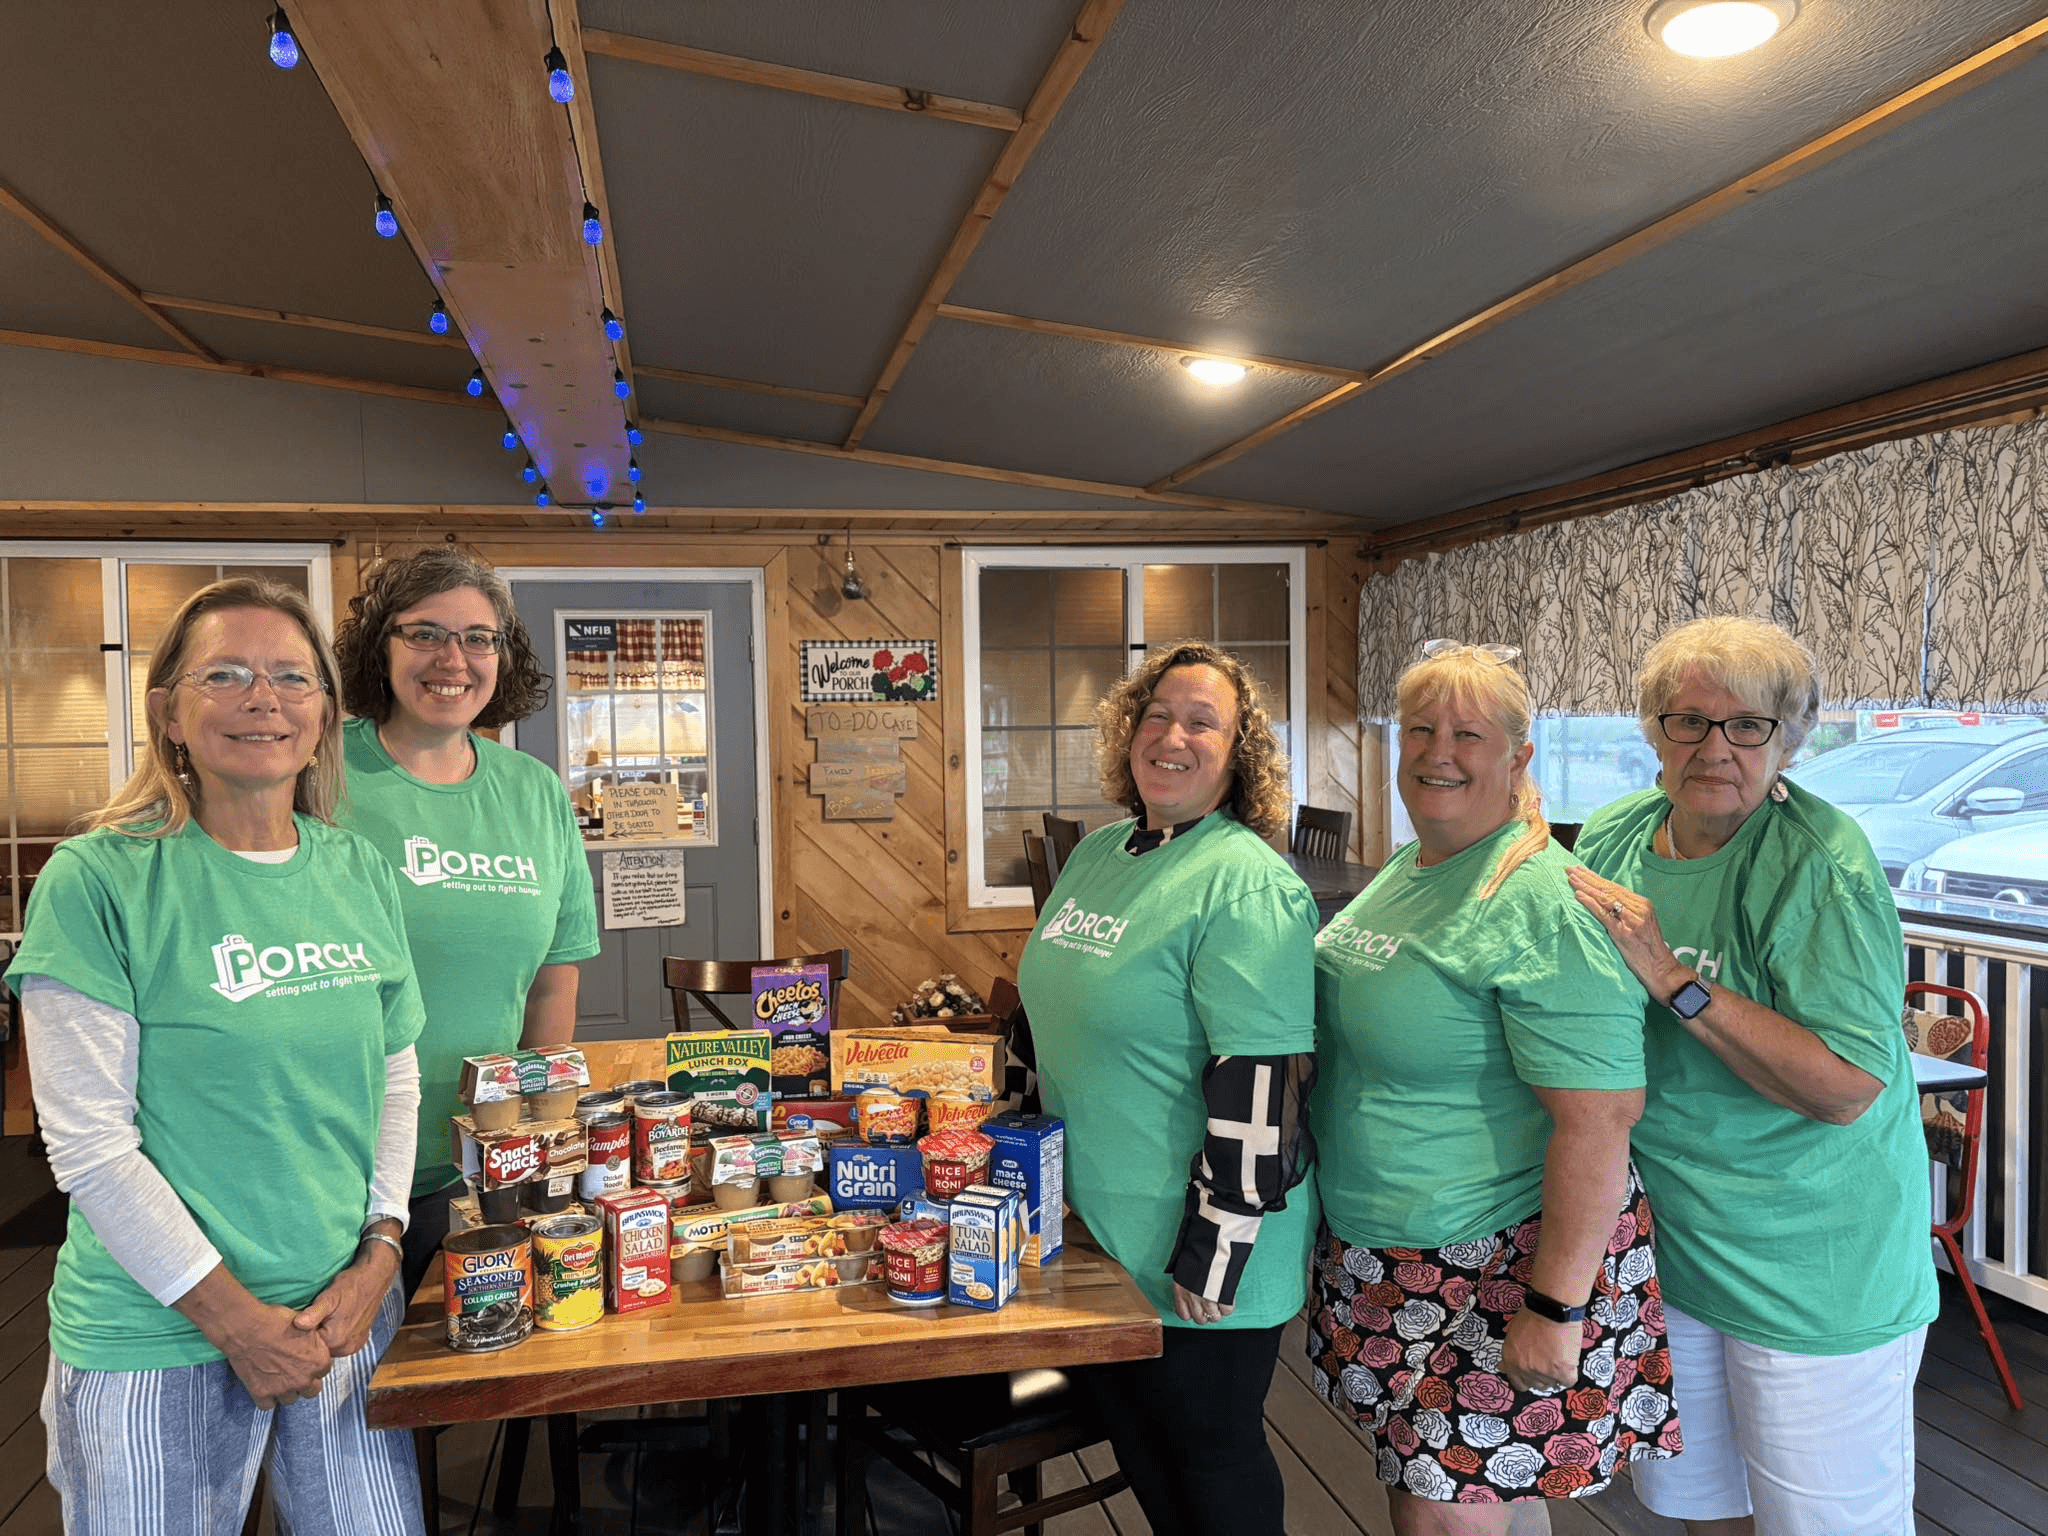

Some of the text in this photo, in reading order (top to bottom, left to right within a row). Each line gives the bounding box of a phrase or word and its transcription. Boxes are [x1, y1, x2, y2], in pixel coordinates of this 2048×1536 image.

[583, 625, 612, 636] NFIB
[812, 651, 870, 689] Welcome
[832, 677, 869, 691] PORCH
[609, 787, 668, 798] PLEASE CHECK
[612, 801, 622, 809] IN
[607, 808, 661, 820] OTHER DOOR TO
[612, 821, 654, 830] BE SEATED
[404, 841, 538, 882] PORCH
[442, 882, 471, 892] setting
[498, 886, 517, 895] fight
[1046, 905, 1129, 944] PORCH
[220, 939, 373, 985] PORCH
[265, 983, 300, 998] setting
[301, 983, 318, 993] out
[319, 979, 331, 989] to
[332, 975, 353, 988] fight
[755, 979, 821, 1020] Cheetos
[670, 1039, 767, 1063] NATURE VALLEY
[845, 1041, 909, 1066] Velveeta
[688, 1057, 749, 1069] LUNCH BOX
[489, 1139, 540, 1168] Snack
[549, 1142, 585, 1157] Chocolate
[501, 1153, 540, 1178] pack
[836, 1158, 896, 1181] Nutri
[934, 1165, 961, 1176] RICE
[995, 1169, 1025, 1181] mac &
[836, 1180, 897, 1198] Grain
[935, 1180, 961, 1190] RONI
[905, 1202, 911, 1210] 4
[622, 1209, 665, 1226] BRUNSWICK
[952, 1209, 993, 1226] BRUNSWICK
[623, 1225, 663, 1243] CHICKEN
[958, 1225, 989, 1242] TUNA
[625, 1238, 663, 1255] SALAD
[954, 1237, 991, 1254] SALAD
[462, 1249, 516, 1274] GLORY
[887, 1254, 911, 1269] RICE
[458, 1270, 523, 1291] SEASONED
[888, 1270, 911, 1283] RONI
[463, 1290, 518, 1306] COLLARD GREENS
